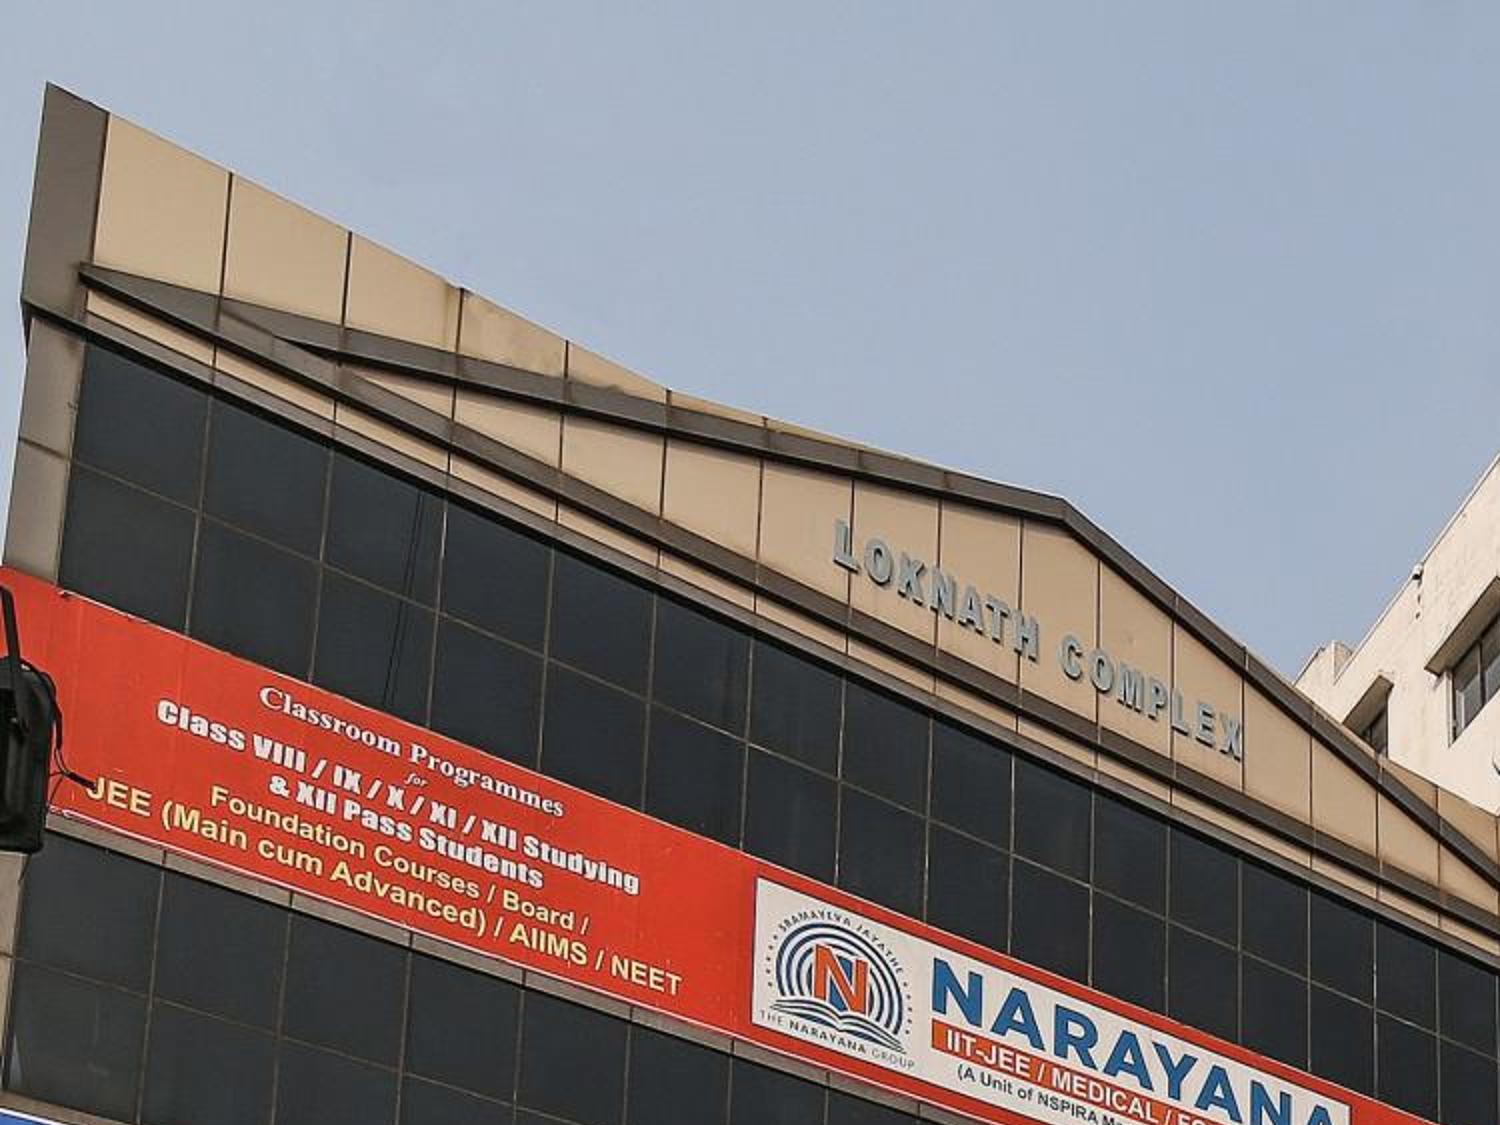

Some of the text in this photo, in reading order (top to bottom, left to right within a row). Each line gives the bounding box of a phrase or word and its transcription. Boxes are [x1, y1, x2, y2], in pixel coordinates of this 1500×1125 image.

[833, 518, 1243, 762] LOKNATH COMPLEX
[157, 699, 640, 896] Class VIII / IX / X / XI / XII Studying
[259, 686, 565, 818] Classroom Programmes
[404, 772, 428, 788] for
[85, 776, 684, 997] JEE (Main cum Advanced) / AIIMS / NEET
[210, 784, 590, 936] Foundation Courses / Board /
[269, 774, 545, 889] & XII Pass Students
[760, 1010, 915, 1070] THE NARAYANA GROUP
[947, 1029, 1031, 1079] IIT-JEE
[1037, 1064, 1045, 1083] /
[1052, 1067, 1160, 1124] MEDICAL
[1164, 1106, 1172, 1124] /
[957, 1063, 977, 1083] (A
[980, 1071, 1014, 1096] Unit
[1017, 1086, 1034, 1101] of
[1037, 1091, 1099, 1125] NSPIRA
